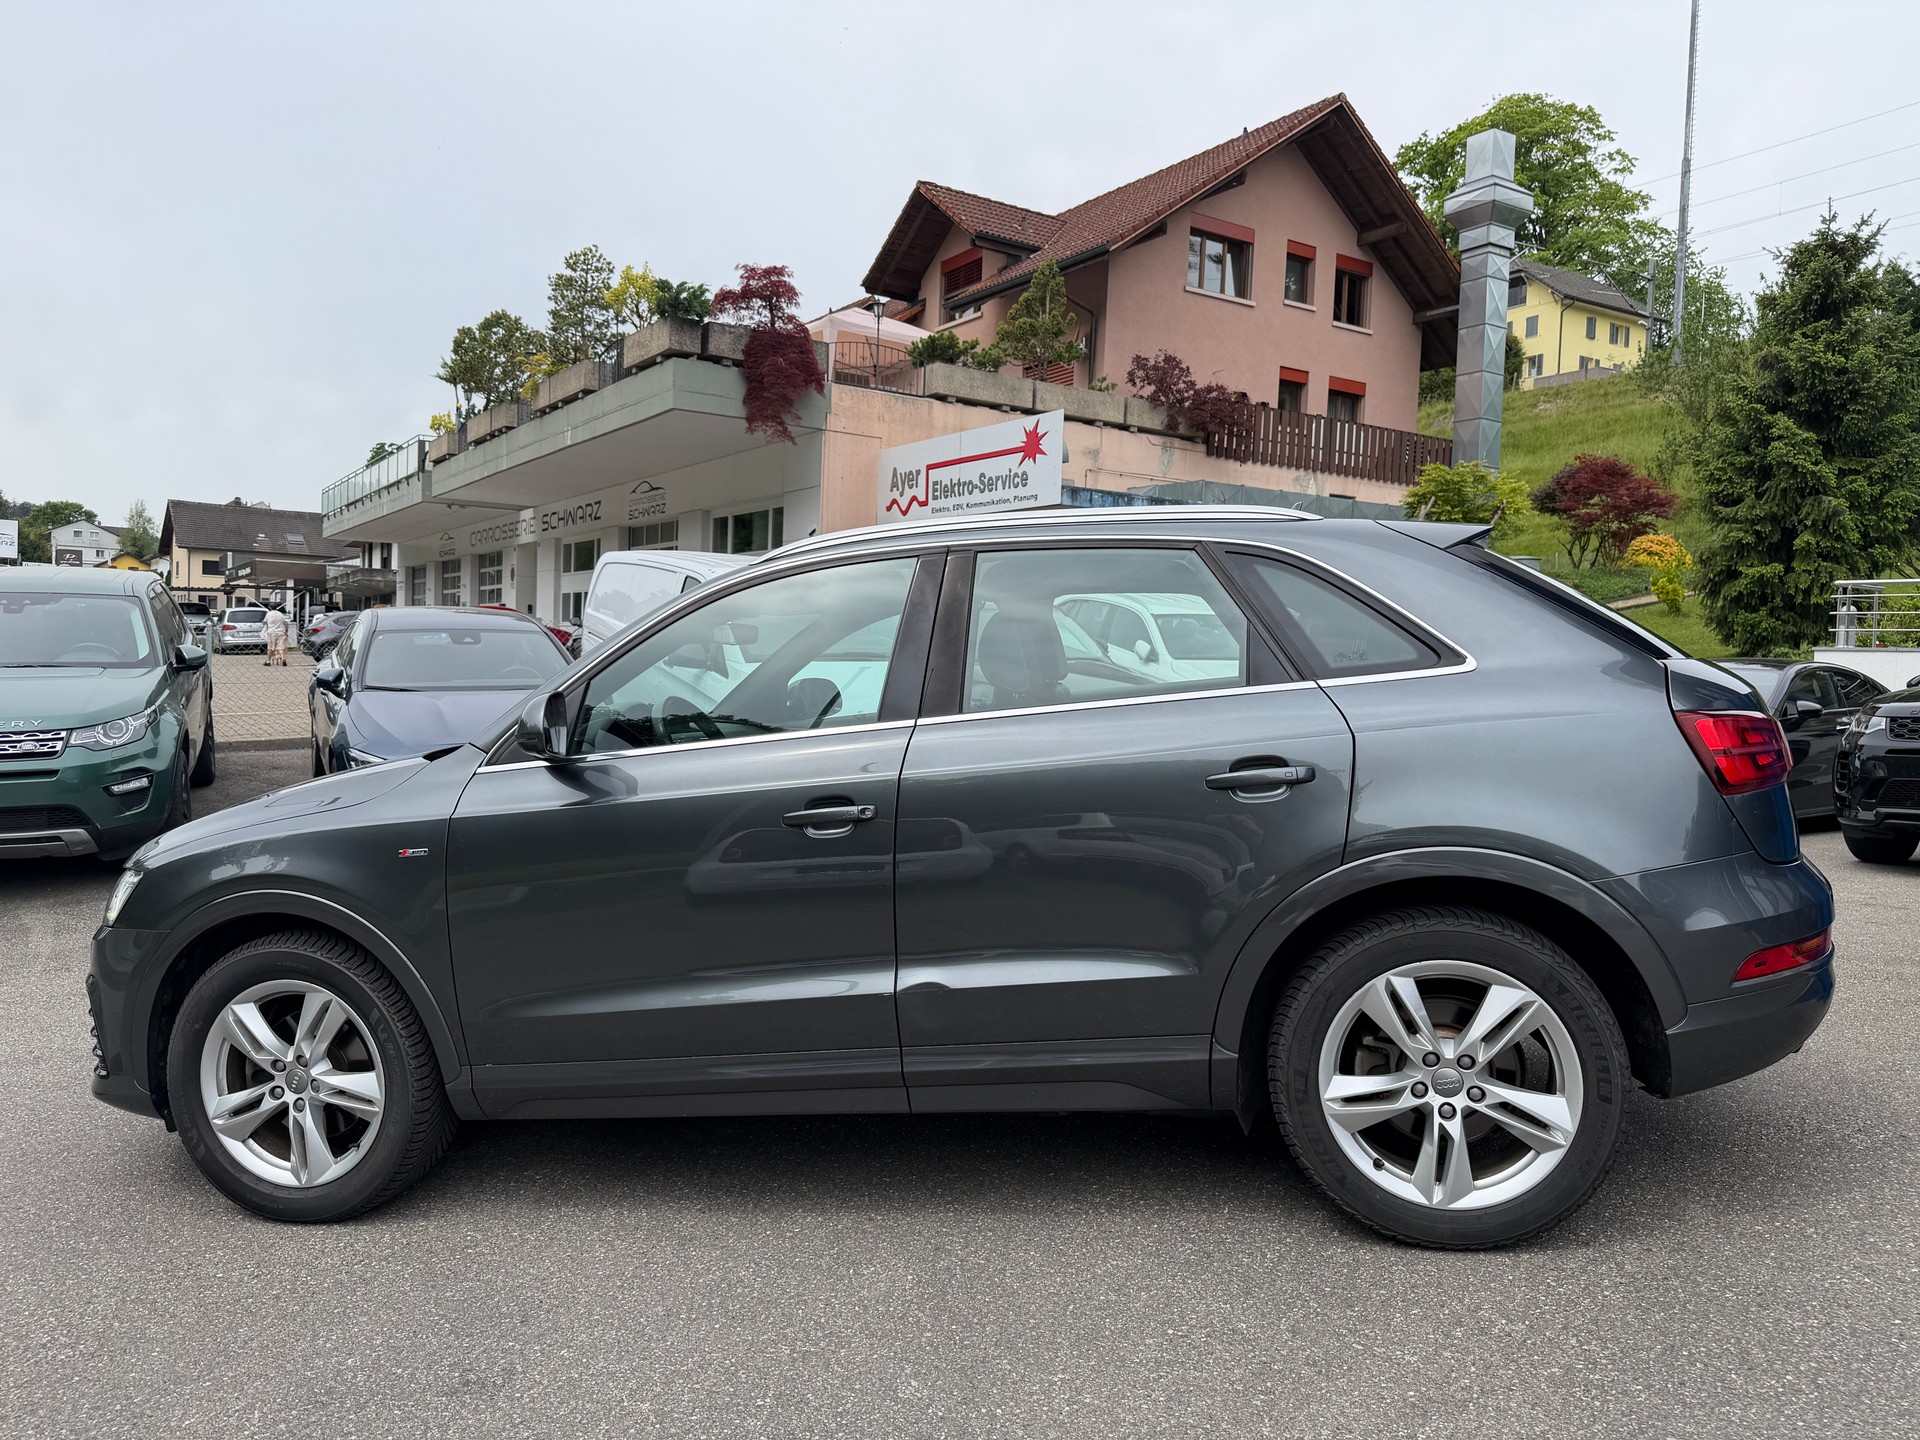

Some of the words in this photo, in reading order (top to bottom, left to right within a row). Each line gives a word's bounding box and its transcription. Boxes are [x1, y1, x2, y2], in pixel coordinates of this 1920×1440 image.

[890, 466, 921, 498] Ayer
[931, 468, 1029, 501] Elektro-Service
[931, 505, 951, 514] Elektro,
[966, 497, 1012, 509] Kommunikation,
[1013, 493, 1038, 503] Planung
[470, 516, 537, 547] CARROSSERIE
[541, 500, 602, 532] SCHWARZ
[1560, 989, 1613, 1100] MICHELIN
